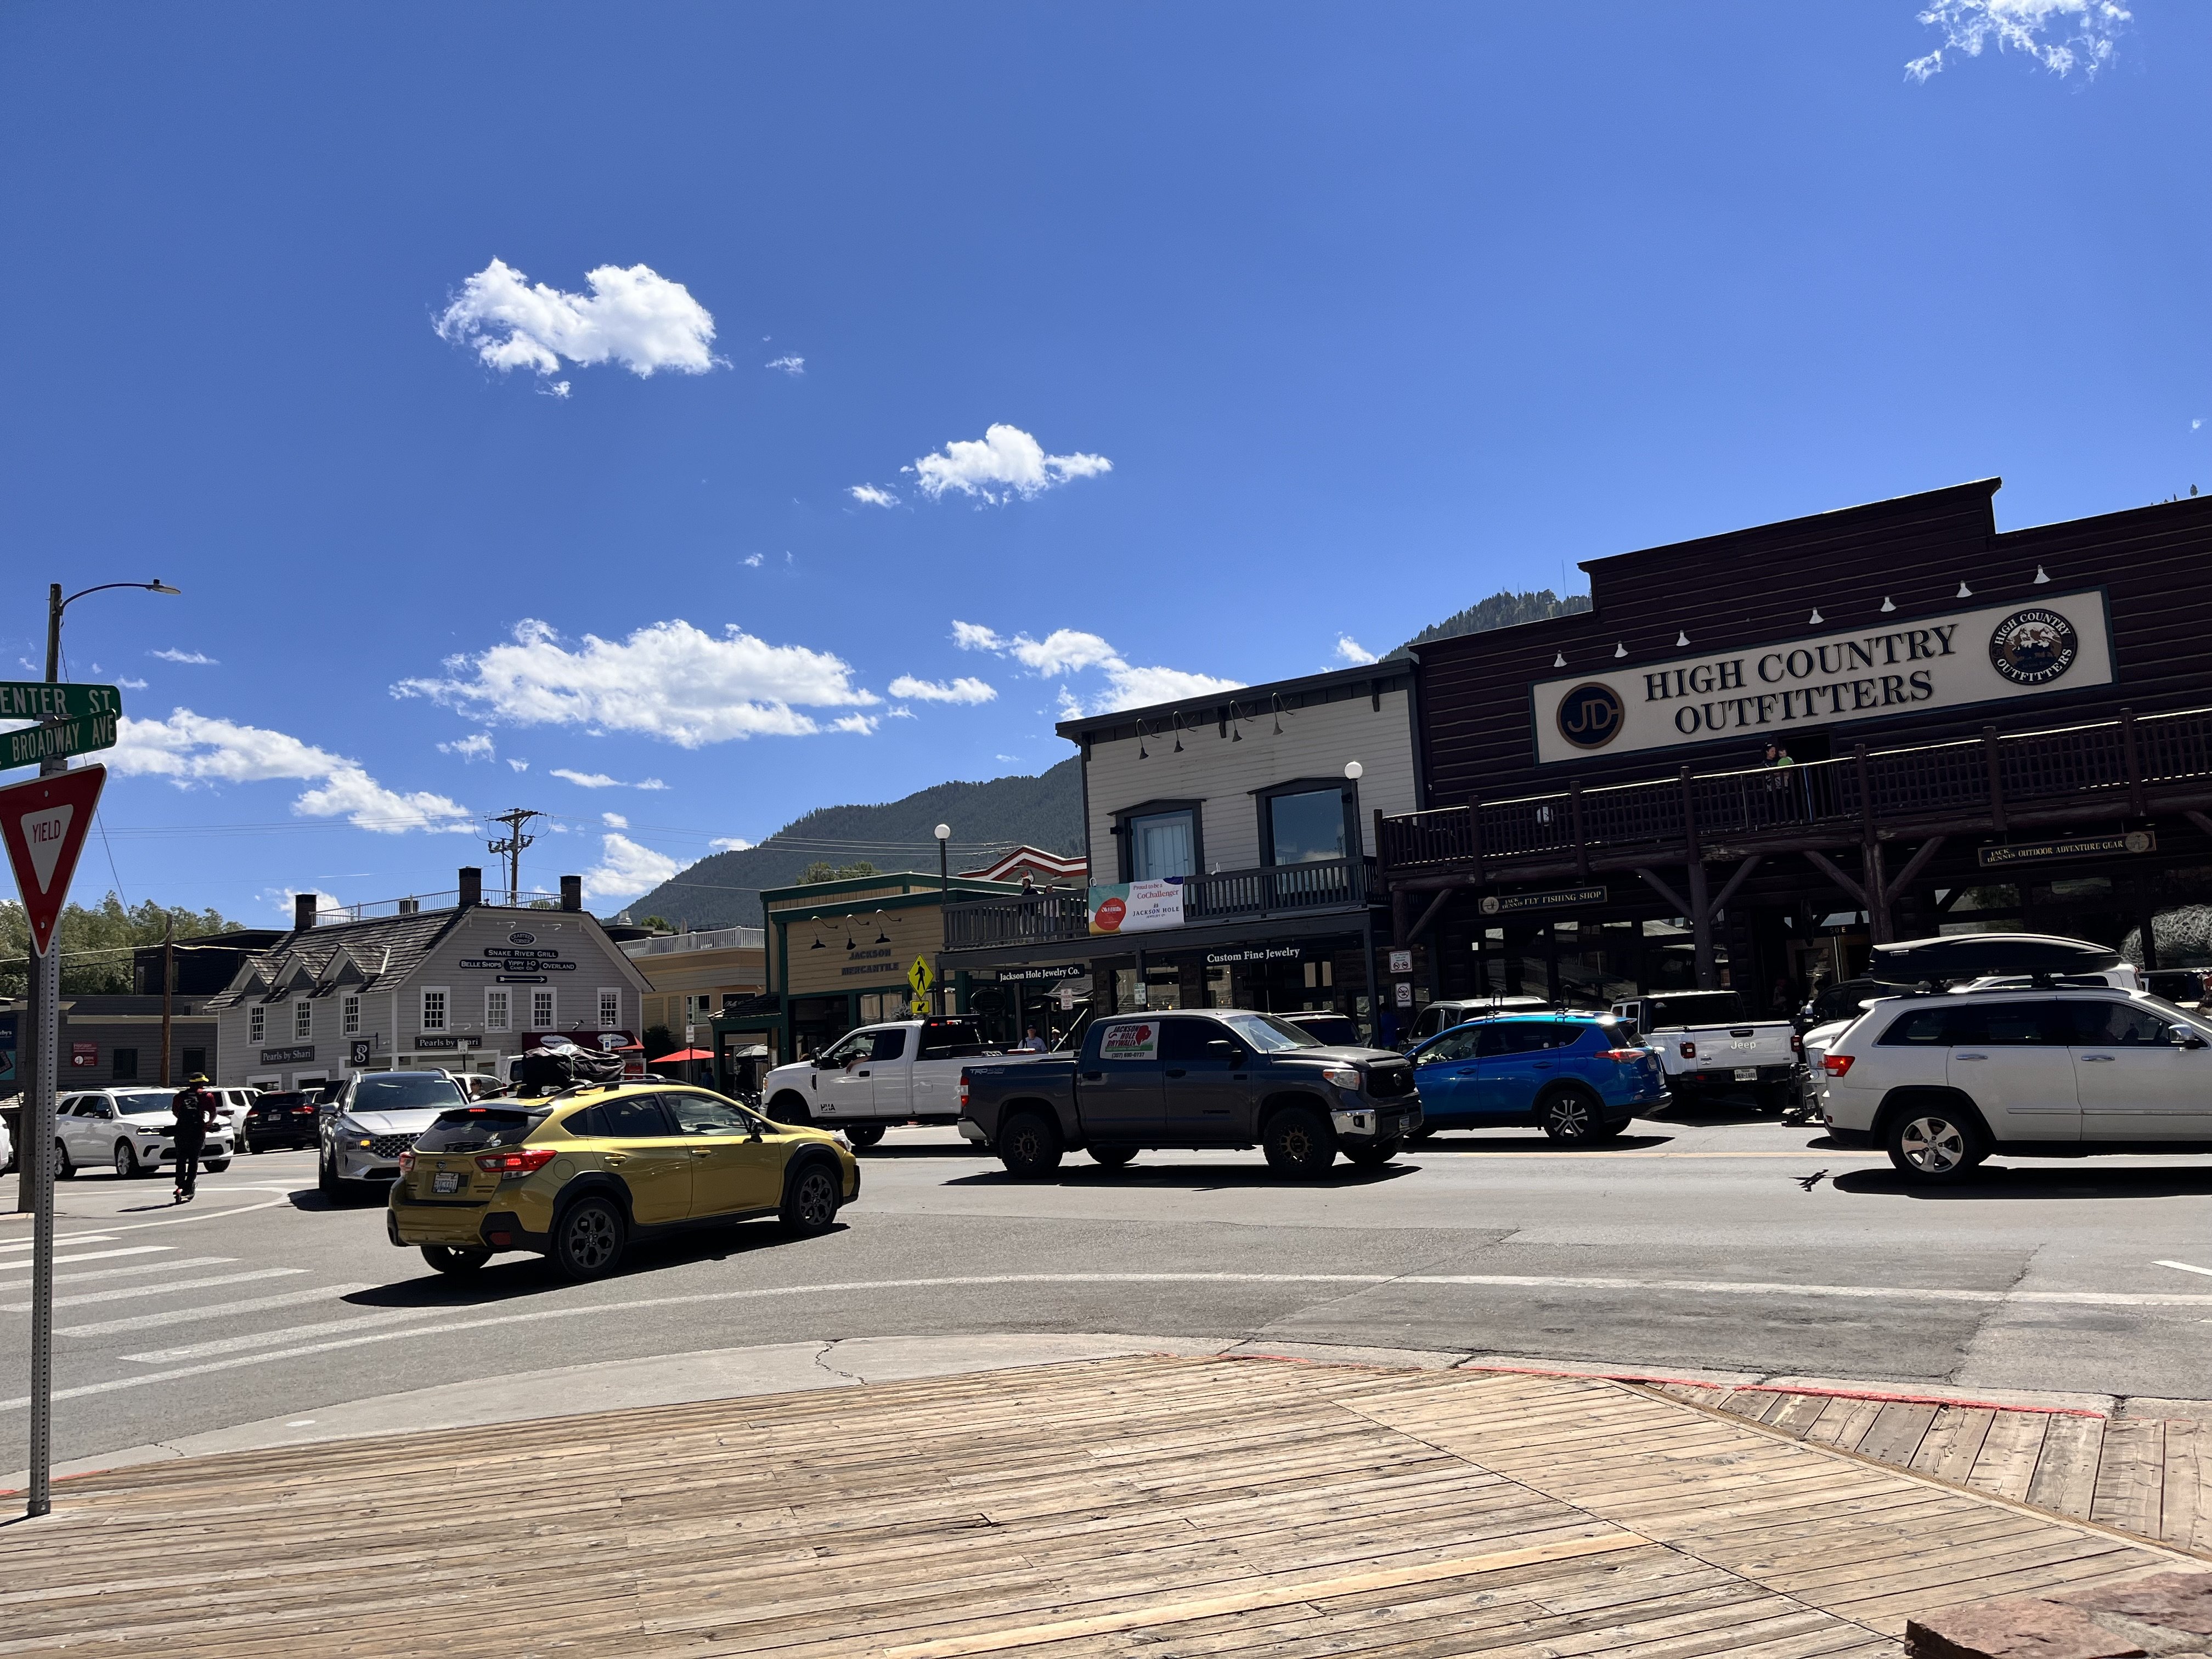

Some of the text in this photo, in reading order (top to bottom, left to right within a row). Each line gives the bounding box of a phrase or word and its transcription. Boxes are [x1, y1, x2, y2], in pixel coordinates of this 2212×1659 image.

[1994, 612, 2072, 645] HIGH COUNTRY
[1643, 624, 1959, 702] HIGH COUNTRY
[1996, 648, 2072, 681] OUTFITTERS
[88, 689, 110, 714] ST
[1674, 670, 1934, 735] OUTFITTERS
[12, 714, 115, 762] BROADWAY AVE
[32, 820, 60, 843] YIELD
[1991, 848, 2009, 856] JACK
[2018, 840, 2123, 857] OUTDOOR ADVENTURE GEAR
[1987, 853, 2015, 863] DENNIS
[1137, 890, 1179, 899] CoChallenger
[1525, 890, 1601, 905] FLY FISHING SHOP
[1133, 909, 1160, 917] JACKSON
[1502, 901, 1523, 910] DENNIS
[848, 949, 891, 960] JACKSON
[1207, 947, 1300, 963] Custom Fine Jewelry
[842, 962, 899, 975] MERCANTILE
[1000, 967, 1080, 982] Jackson Hole Jewelry Co.
[419, 1039, 444, 1047] Pearls
[445, 1039, 455, 1047] by
[1730, 1041, 1756, 1050] Jeep
[263, 1048, 311, 1061] Pearls by Shari
